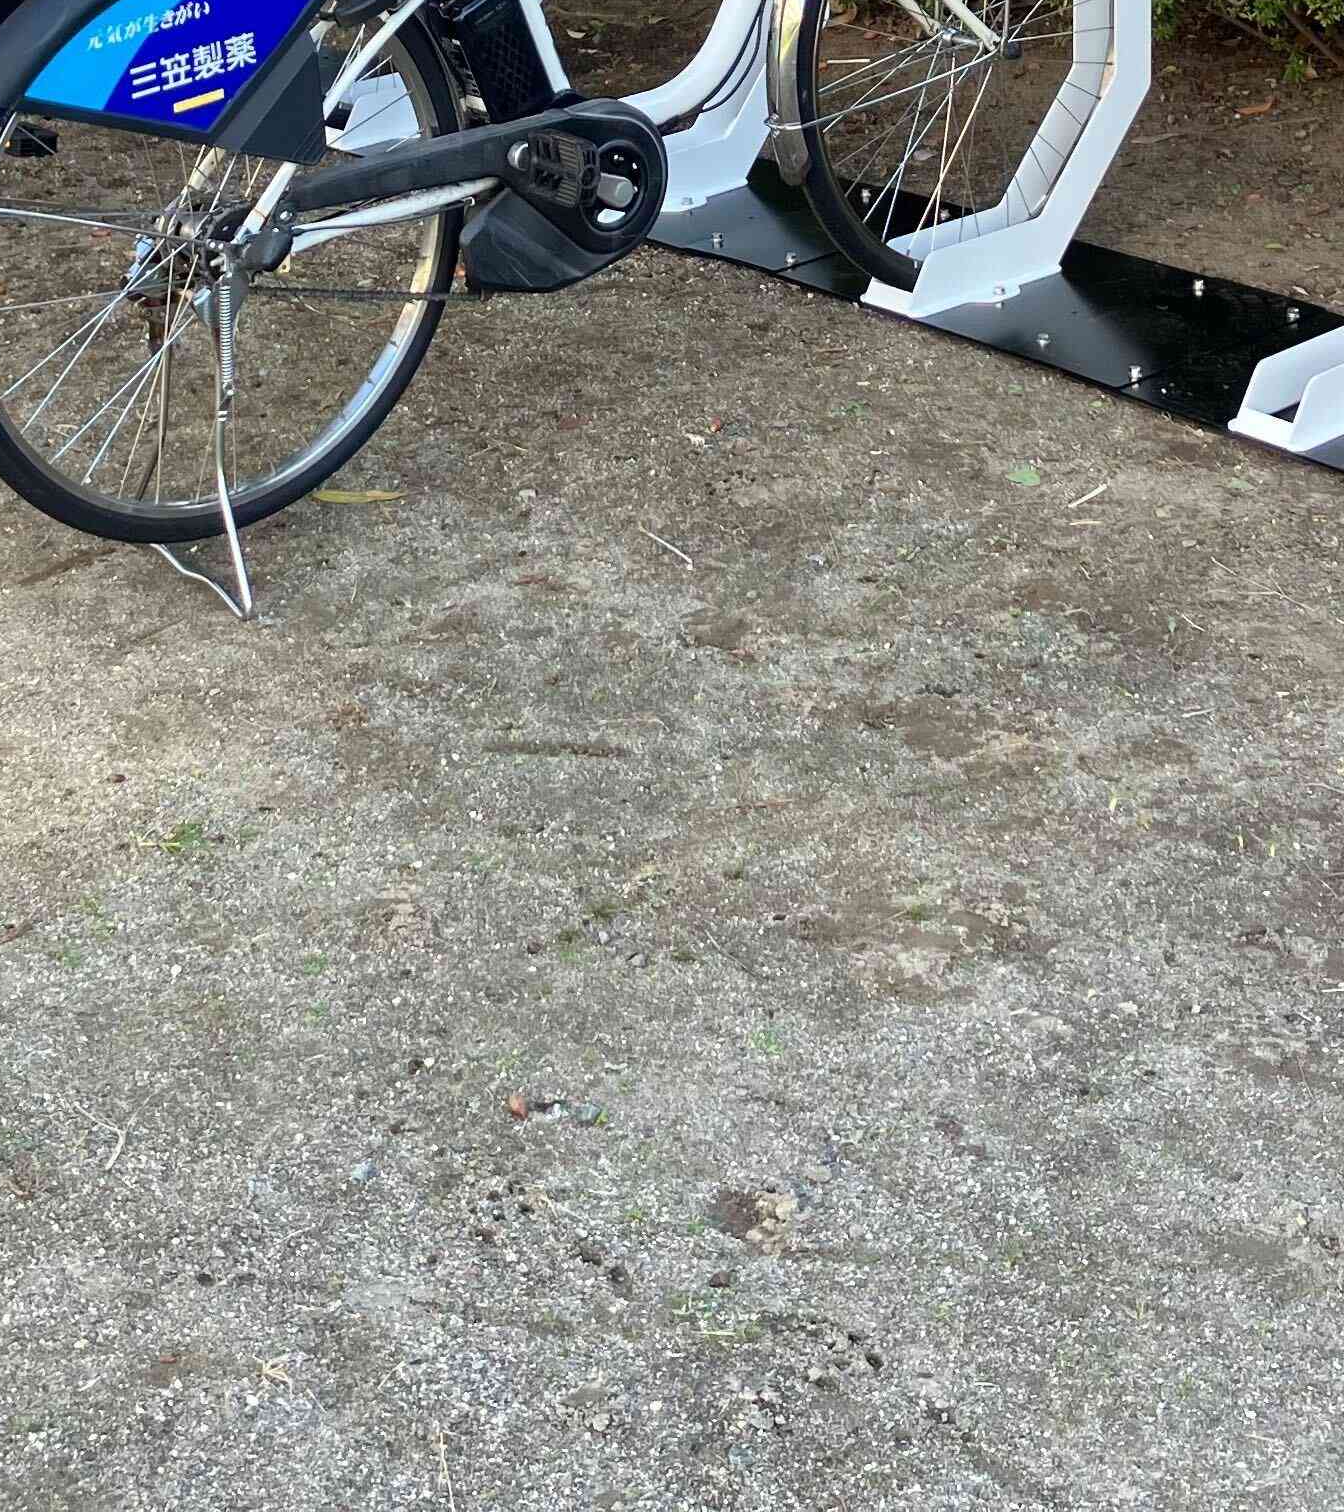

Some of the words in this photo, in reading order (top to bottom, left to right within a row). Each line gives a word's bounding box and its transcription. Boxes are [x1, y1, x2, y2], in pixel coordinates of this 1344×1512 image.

[87, 0, 211, 51] 元気が生きがい
[129, 31, 257, 100] 三笠製薬
